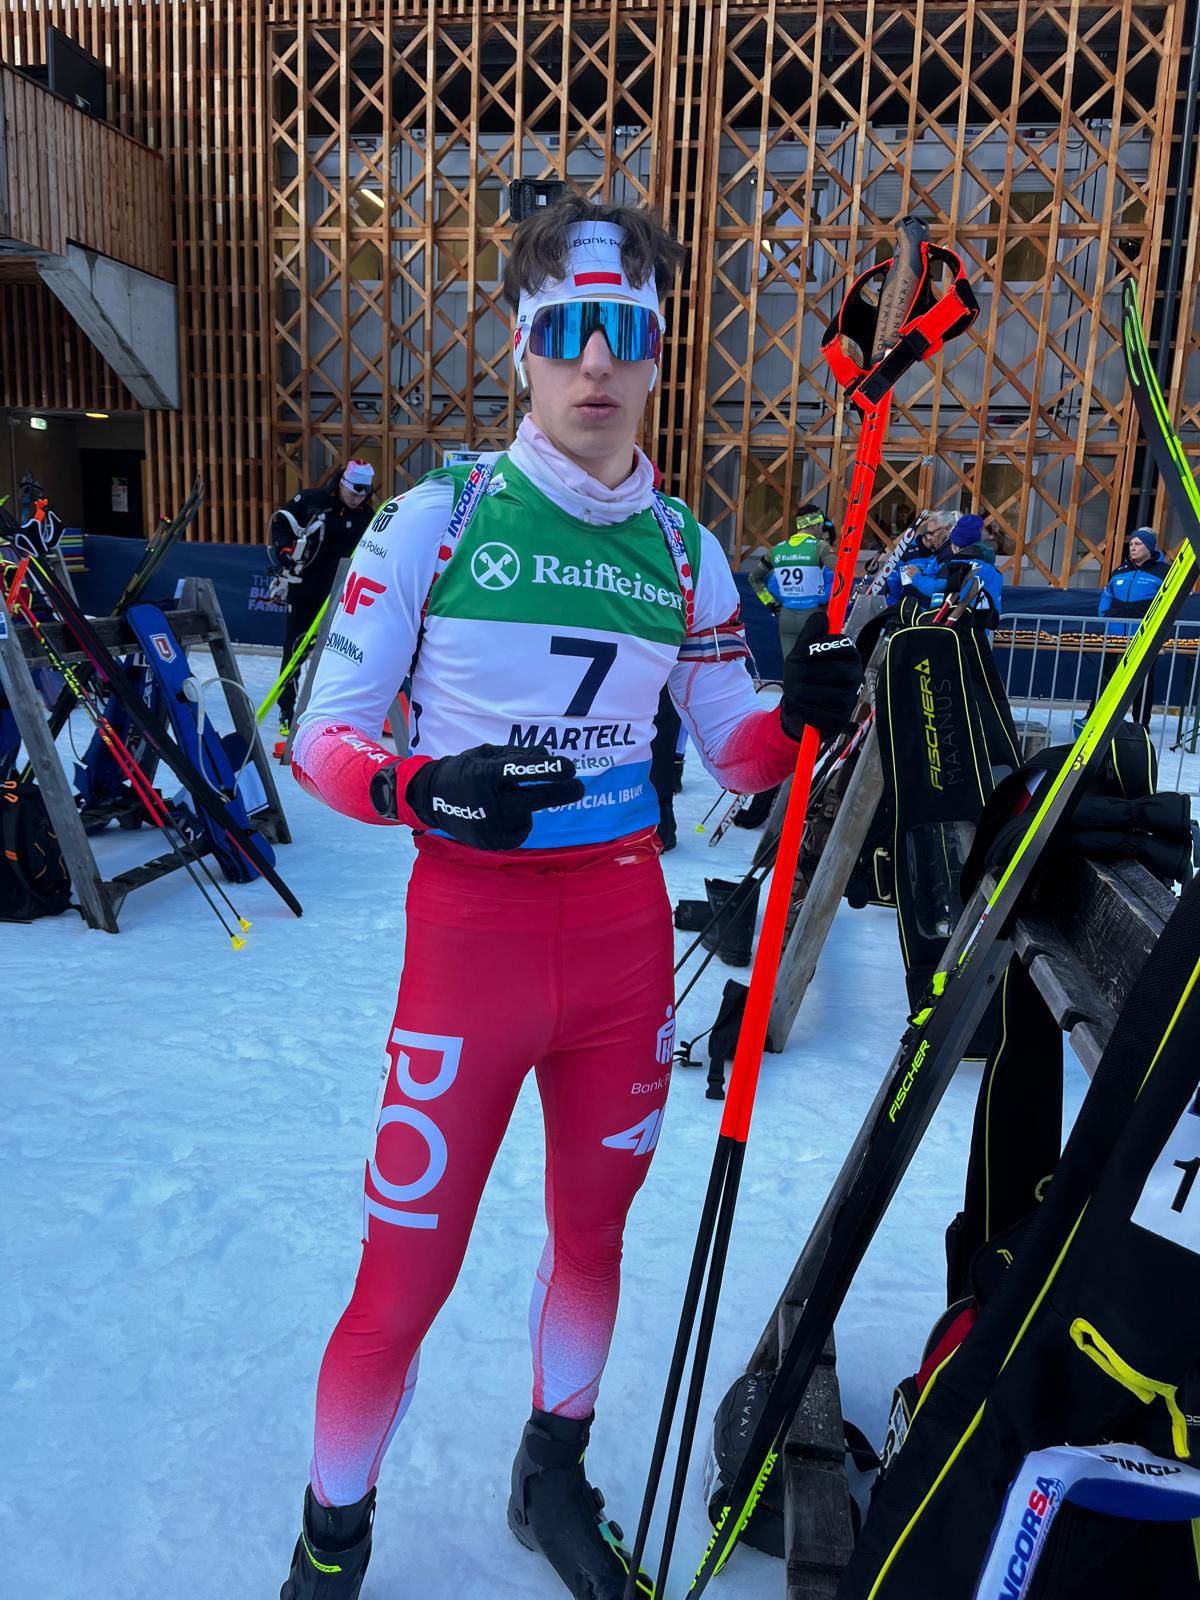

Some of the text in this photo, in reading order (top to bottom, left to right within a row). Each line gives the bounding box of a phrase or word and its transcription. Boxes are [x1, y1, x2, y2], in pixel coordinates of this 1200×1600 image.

[573, 236, 607, 247] Bank
[447, 463, 486, 538] INCORSA
[366, 540, 388, 559] Polski
[780, 567, 803, 586] 29
[532, 554, 683, 610] Raiffeisen
[549, 635, 618, 717] 7
[507, 723, 636, 751] MARTELL
[919, 674, 944, 791] FISCHER
[631, 1077, 663, 1094] Bank
[888, 1039, 930, 1123] FISCHER
[360, 1026, 465, 1244] POL
[739, 1379, 758, 1438] ONE WAY
